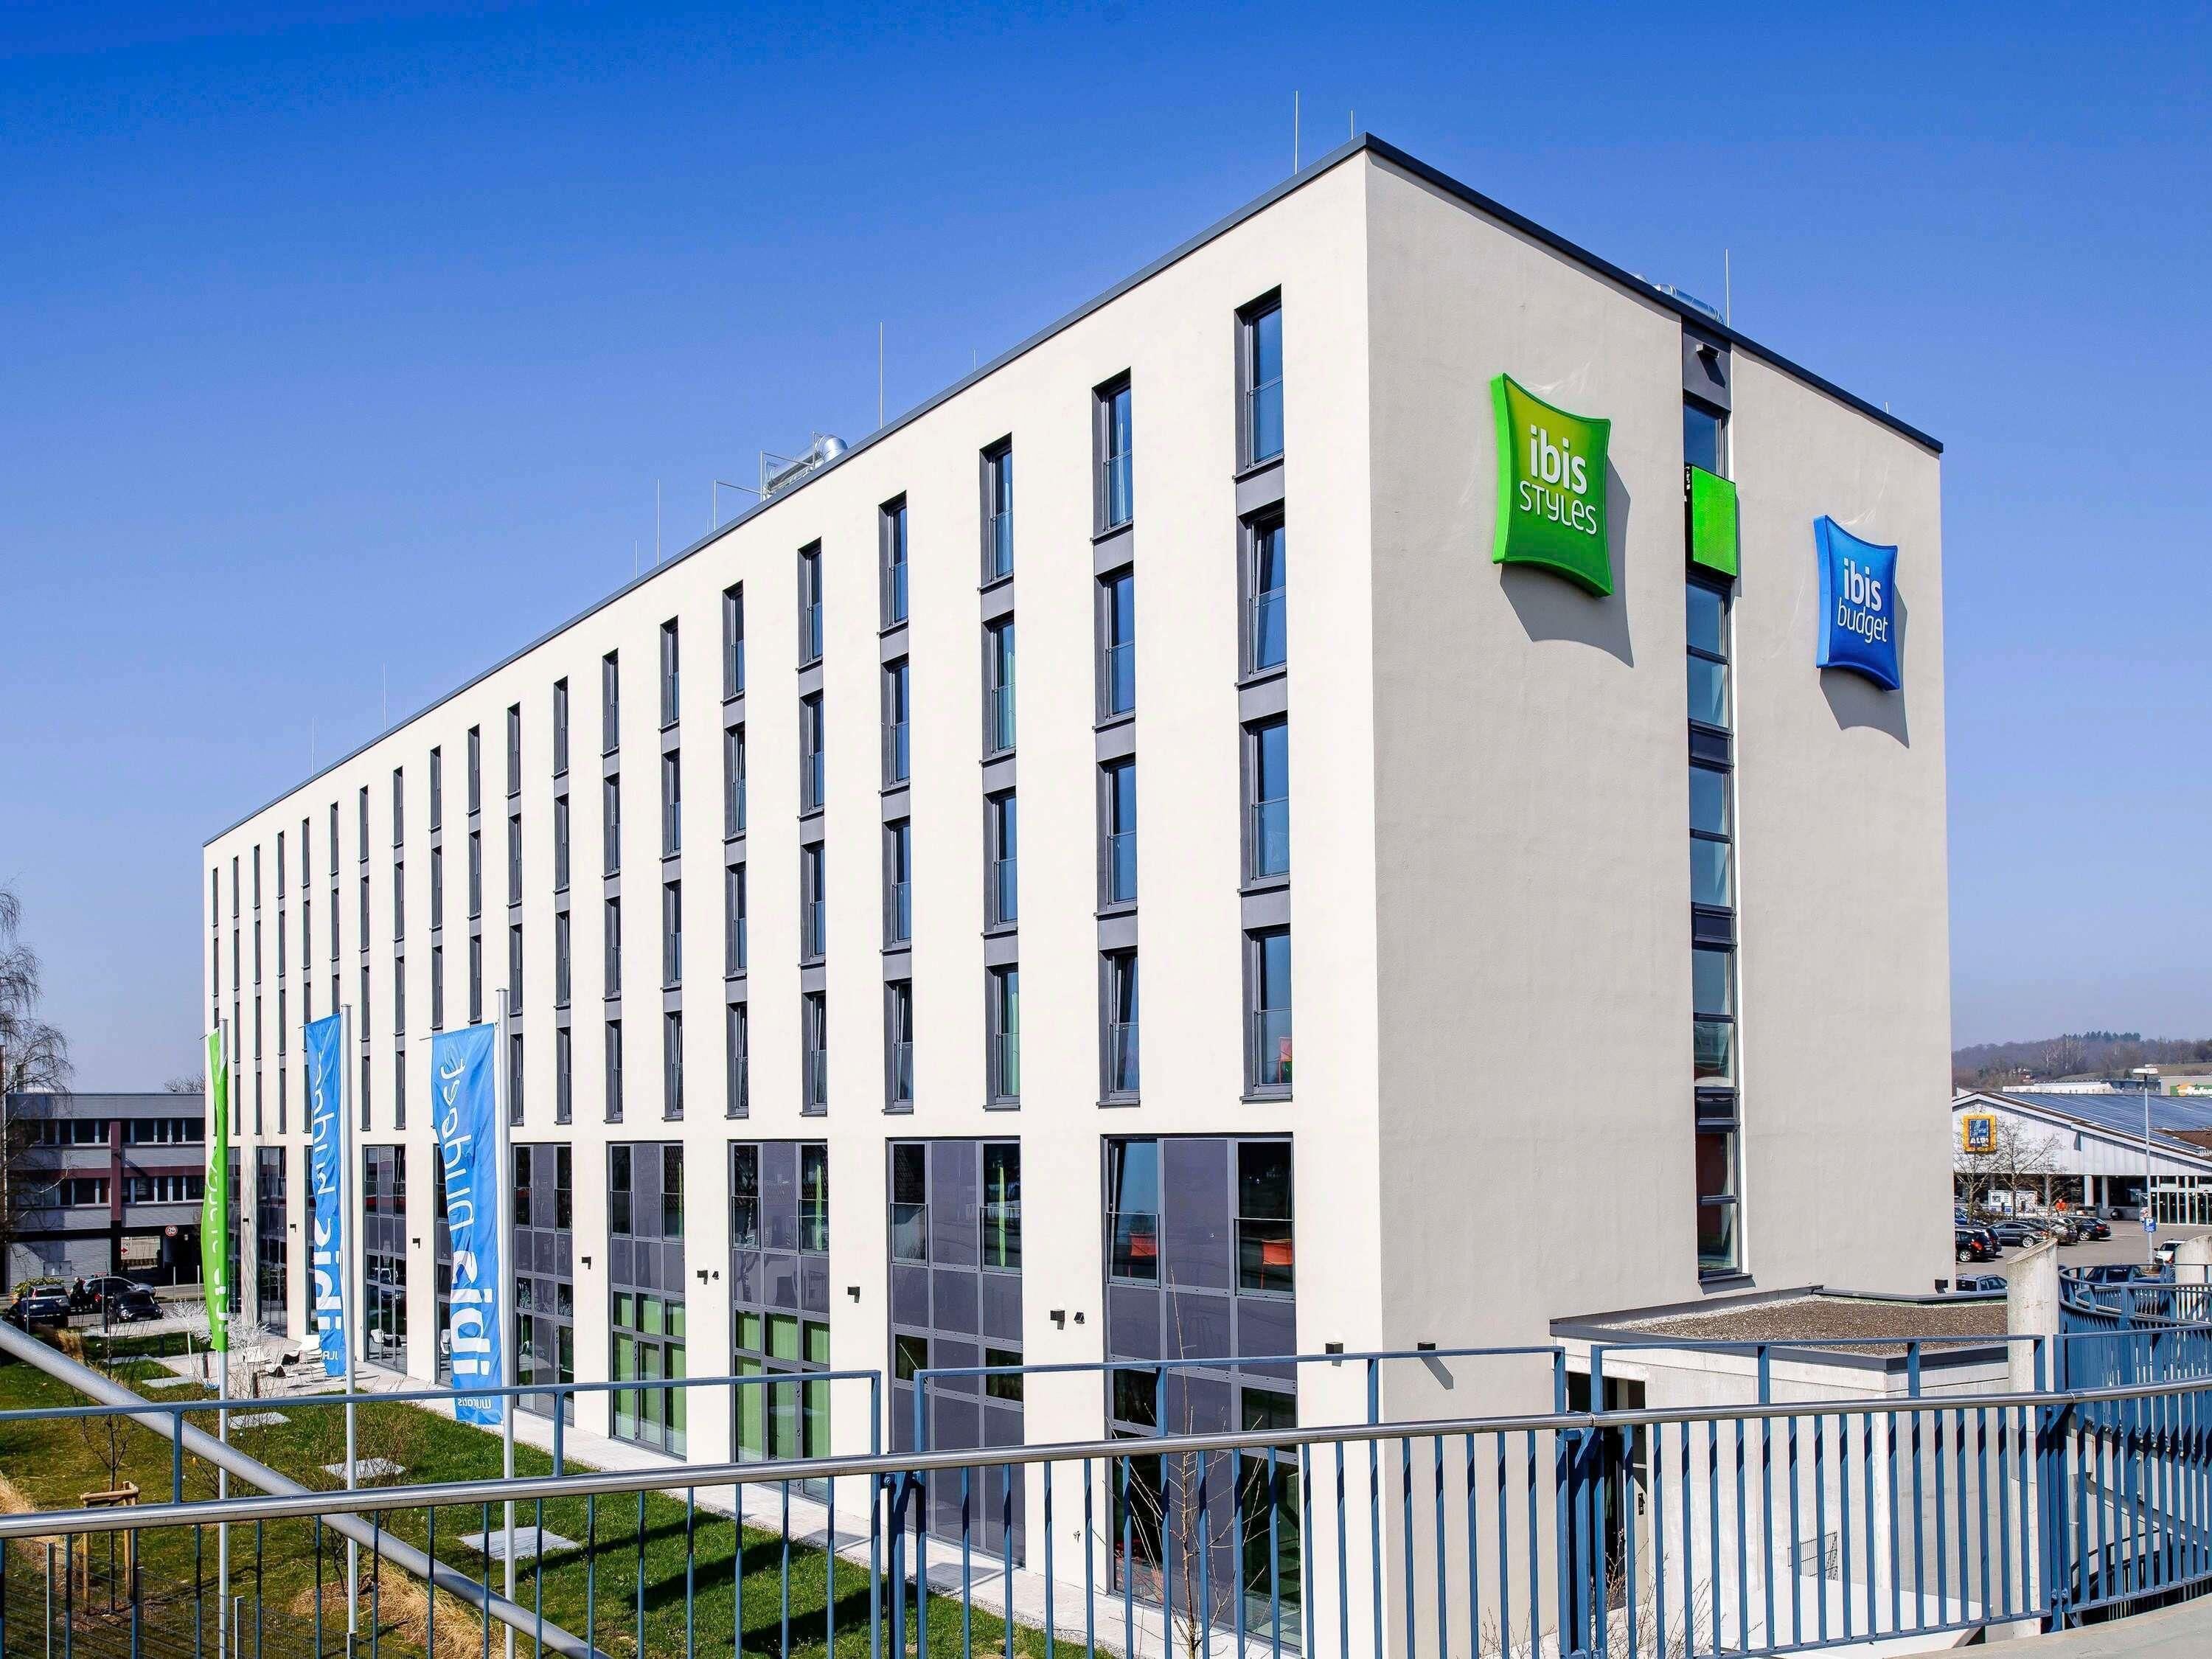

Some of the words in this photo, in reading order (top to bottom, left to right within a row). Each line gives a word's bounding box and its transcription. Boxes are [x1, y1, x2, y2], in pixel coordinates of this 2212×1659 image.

[1530, 424, 1587, 495] ibis
[1844, 557, 1882, 611] ibis
[1837, 597, 1888, 644] budget
